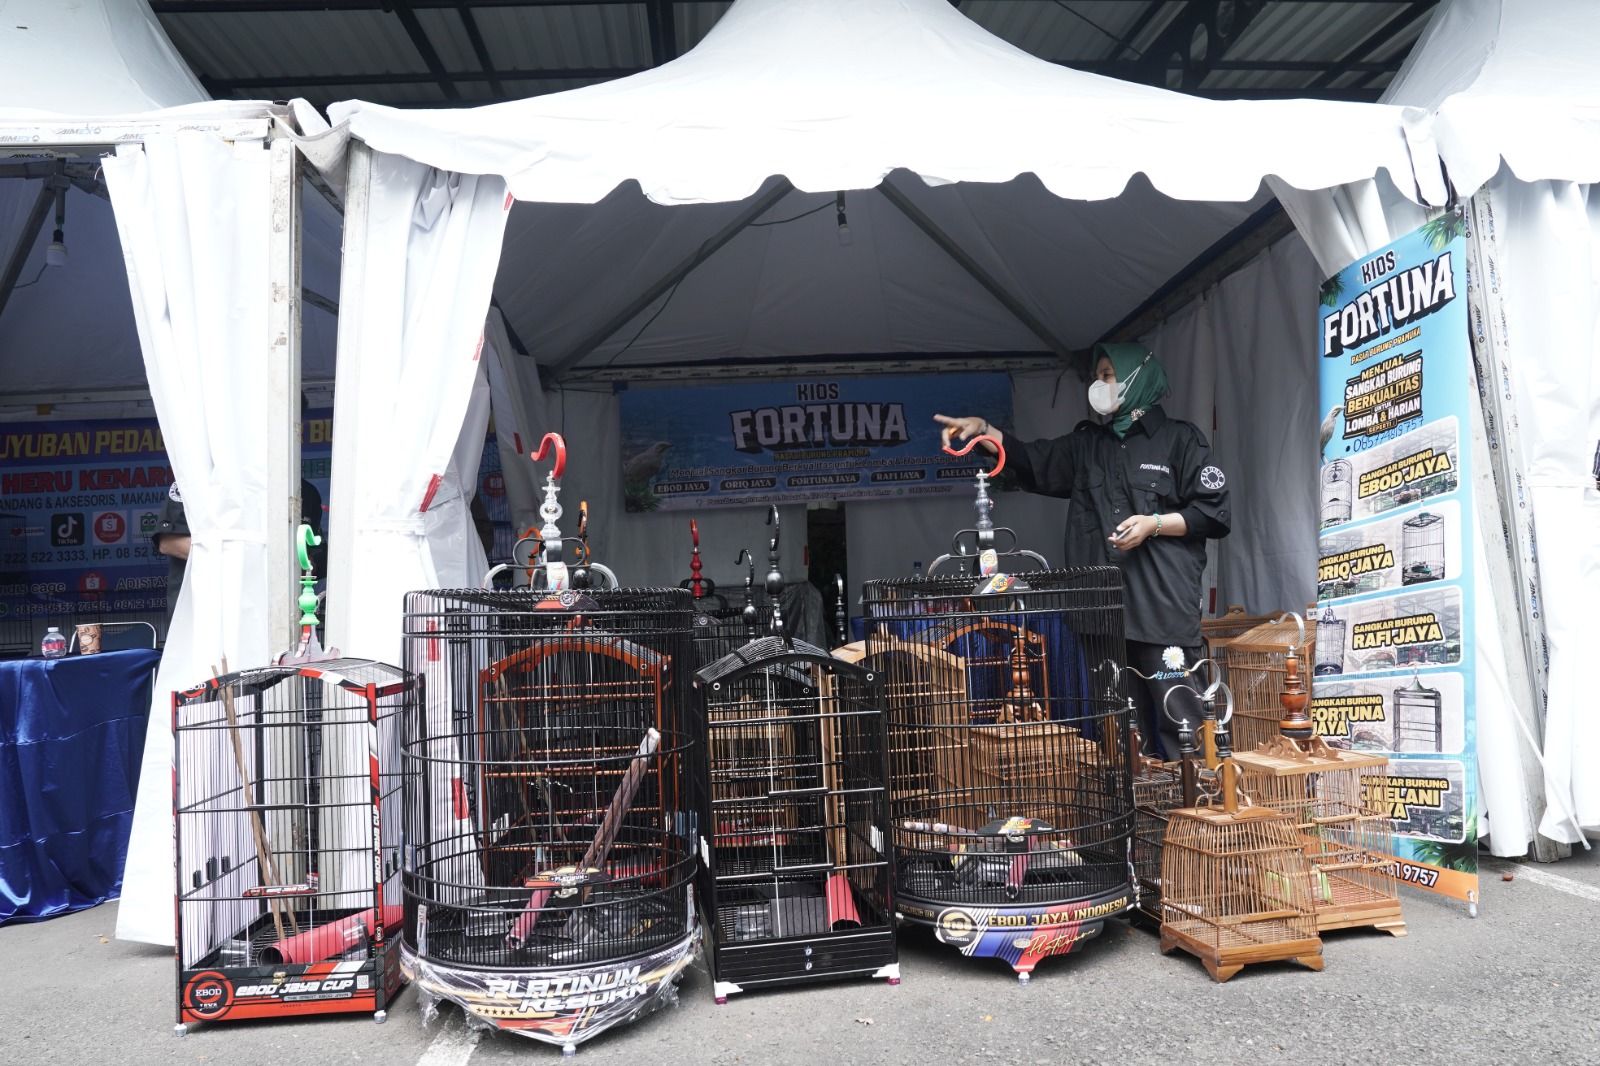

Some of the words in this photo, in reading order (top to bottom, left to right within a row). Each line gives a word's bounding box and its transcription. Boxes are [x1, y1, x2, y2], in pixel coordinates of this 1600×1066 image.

[1362, 250, 1396, 284] KIOS
[1324, 251, 1456, 356] FORTUNA
[1346, 373, 1385, 399] SANGKAR
[1387, 358, 1421, 384] BURUNG
[1361, 355, 1404, 380] MENJUAL
[797, 382, 840, 400] KIOS
[1347, 375, 1419, 413] BERKUALITAS
[730, 403, 909, 452] FORTUNA
[1346, 413, 1379, 433] LOMBA
[1380, 411, 1387, 422] &
[1387, 397, 1420, 420] HARIAN
[876, 472, 898, 481] RAFI
[900, 470, 921, 479] JAYA
[1359, 461, 1398, 482] SANGKAR
[1397, 449, 1433, 468] BURUNG
[1359, 475, 1404, 498] EBOD
[1403, 454, 1451, 482] JAYA
[3, 470, 73, 495] HERU
[657, 483, 682, 493] EBOD
[684, 482, 706, 491] JAYA
[725, 480, 750, 489] ORIQ
[751, 478, 772, 488] JAYA
[791, 475, 834, 486] FORTUNA
[835, 474, 857, 483] JAYA
[1319, 552, 1349, 566] ANGKAR
[1349, 545, 1385, 559] BURUNG
[1351, 551, 1394, 574] JAYA
[1353, 631, 1392, 650] RAFI
[1392, 623, 1443, 645] JAYA
[1354, 622, 1394, 634] SANGKAR
[1394, 614, 1434, 628] BURUNG
[1347, 695, 1383, 706] BURUNG
[1405, 778, 1449, 789] BURUNG
[988, 912, 1027, 928] EBOD
[1031, 909, 1071, 926] JAYA
[1074, 896, 1128, 920] INDONESIA
[195, 988, 222, 997] EBOD
[321, 979, 355, 991] CUP
[486, 966, 642, 998] PLATINUM
[518, 983, 649, 1013] REBORN
